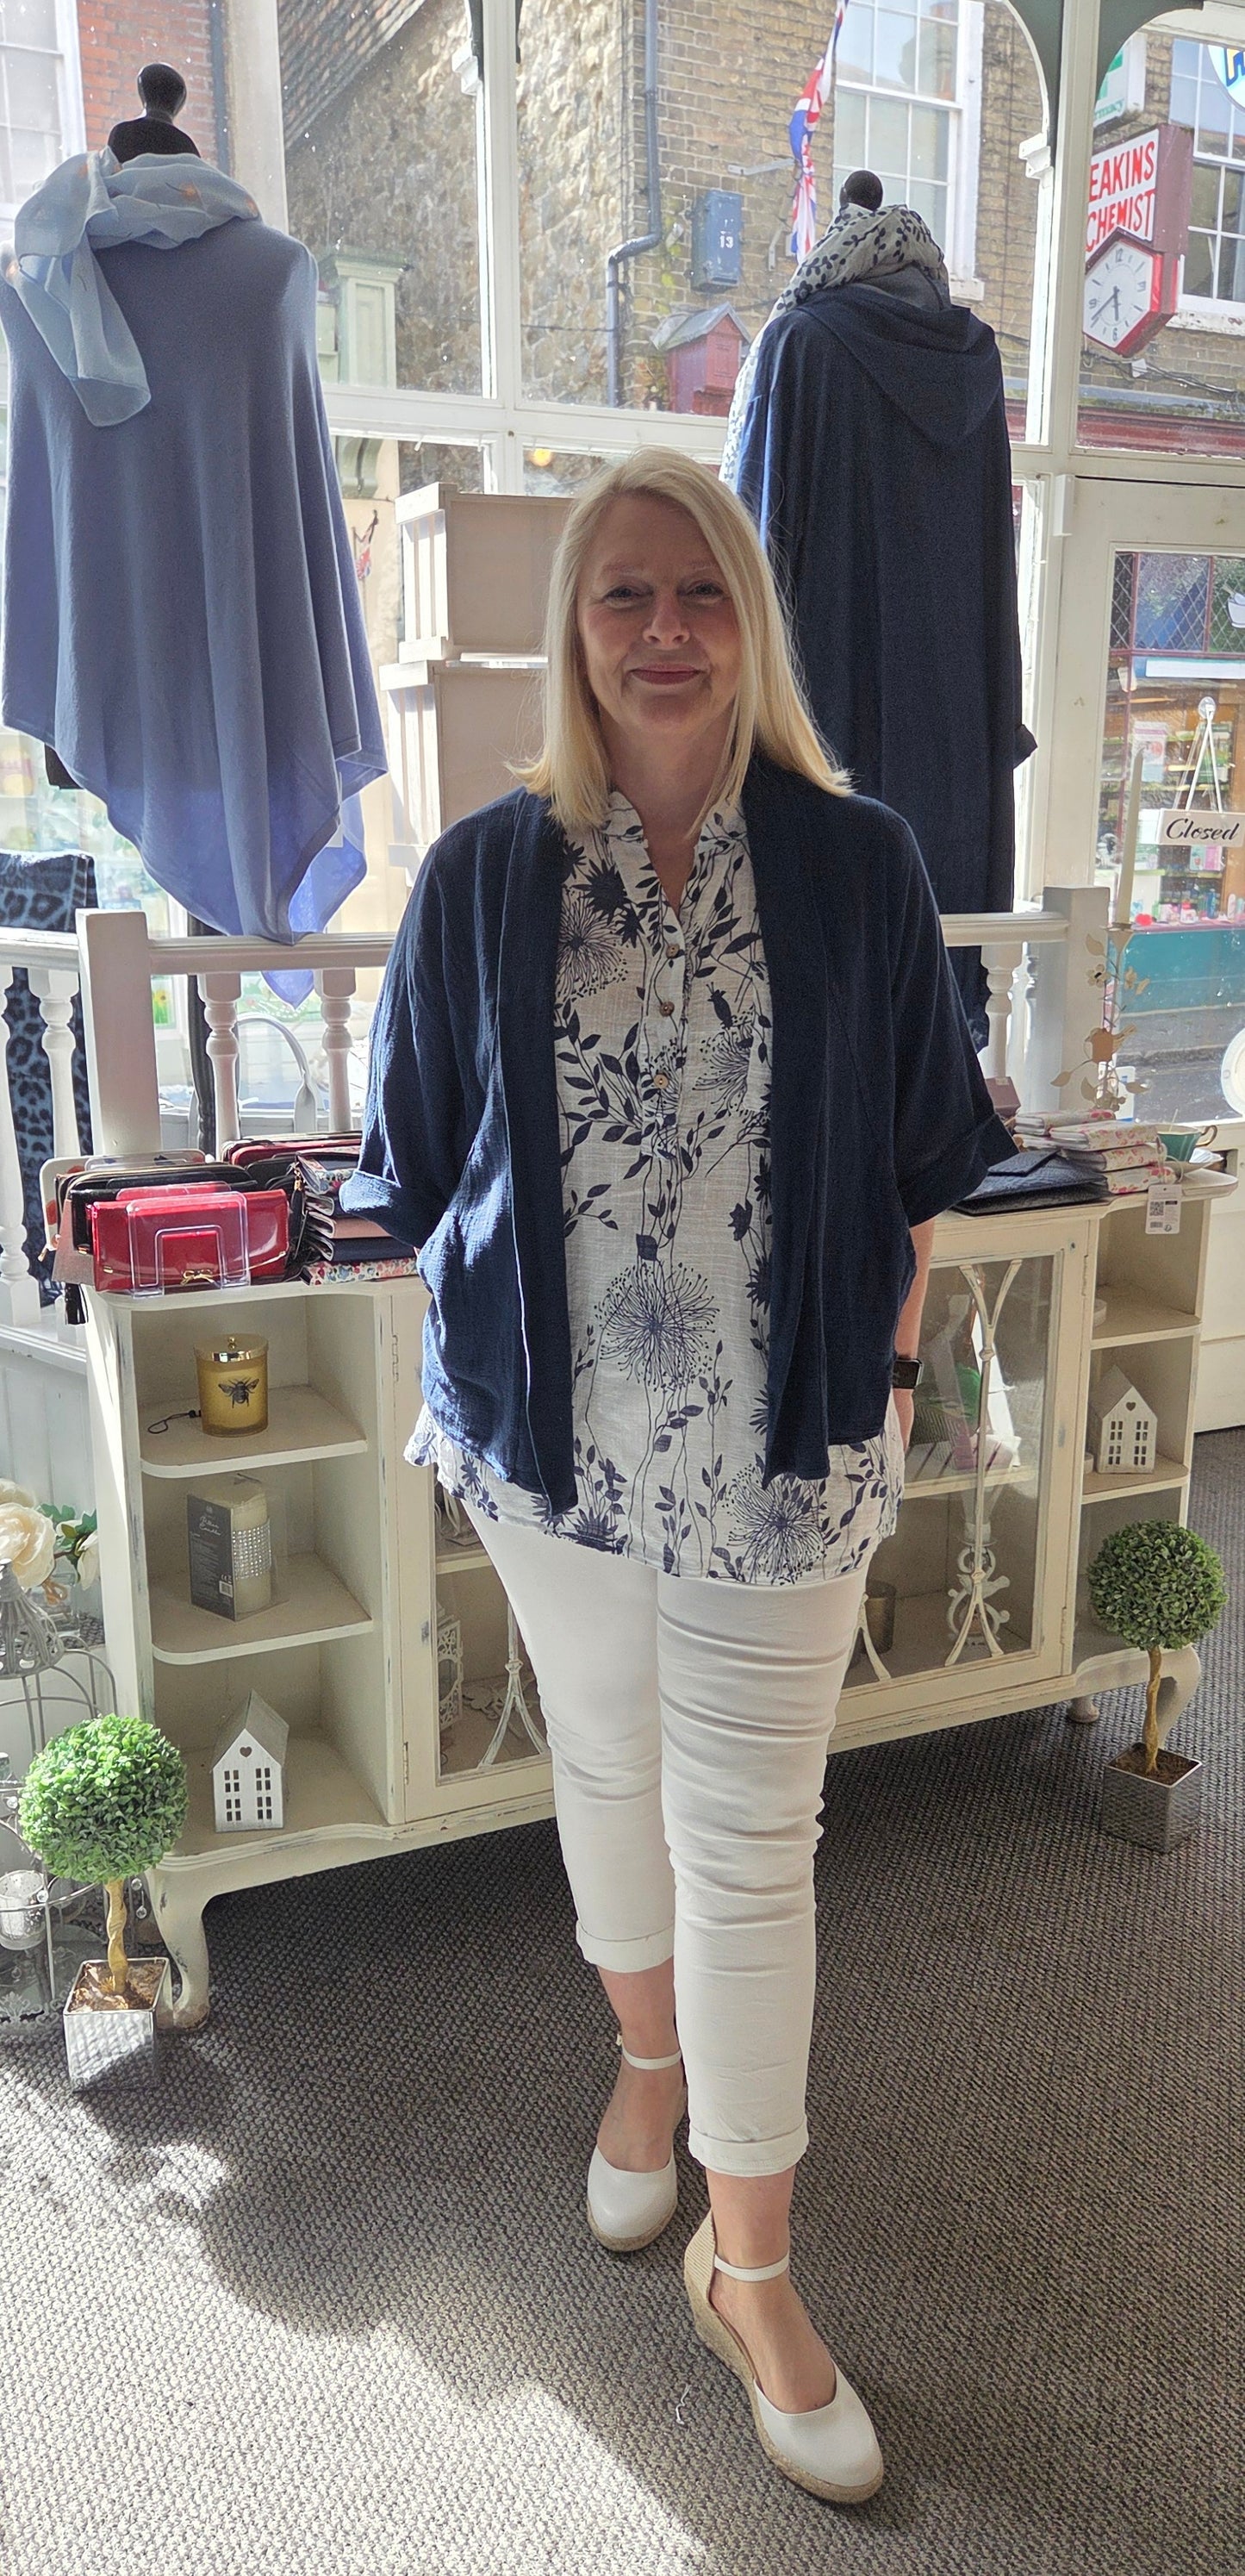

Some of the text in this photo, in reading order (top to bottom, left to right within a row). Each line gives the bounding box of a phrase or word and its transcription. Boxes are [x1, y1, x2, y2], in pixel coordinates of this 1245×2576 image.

[1086, 188, 1157, 253] CHEMIST
[719, 235, 734, 249] 13
[1166, 818, 1240, 840] Closed
